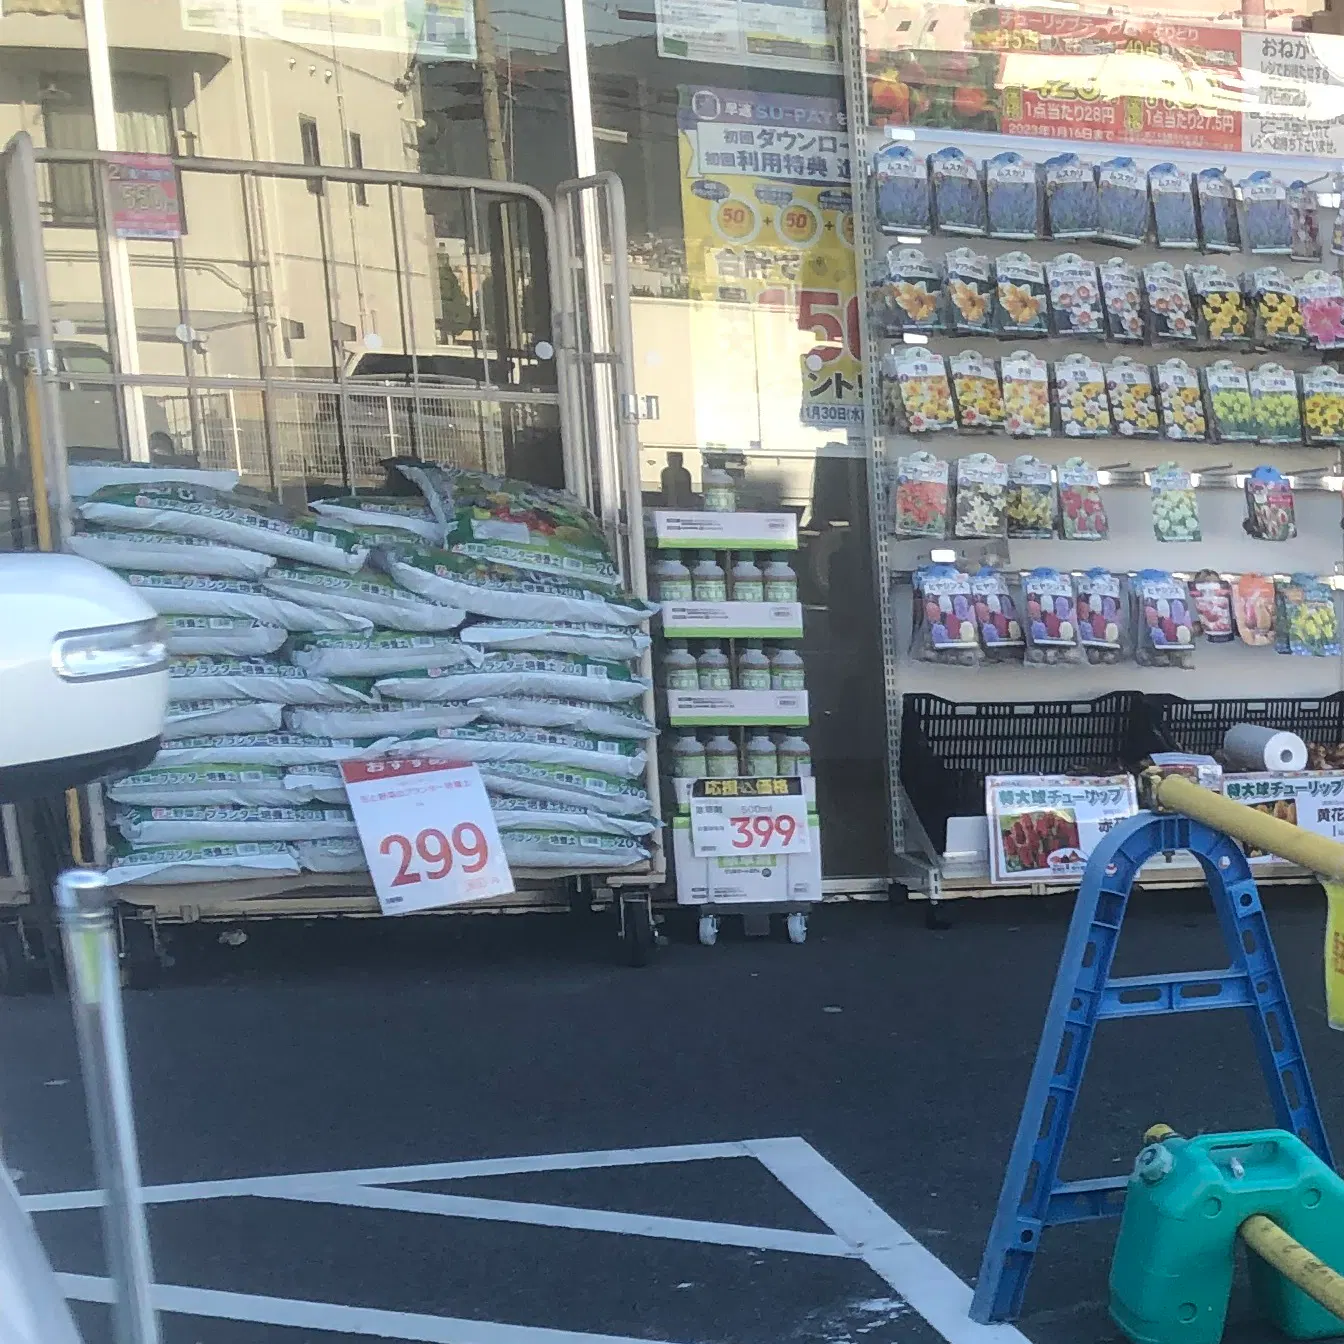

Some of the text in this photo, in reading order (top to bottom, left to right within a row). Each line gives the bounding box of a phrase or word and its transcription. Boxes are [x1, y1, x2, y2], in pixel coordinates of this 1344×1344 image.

[730, 814, 797, 848] 399
[1317, 807, 1344, 823] 黄花
[379, 822, 489, 888] 299
